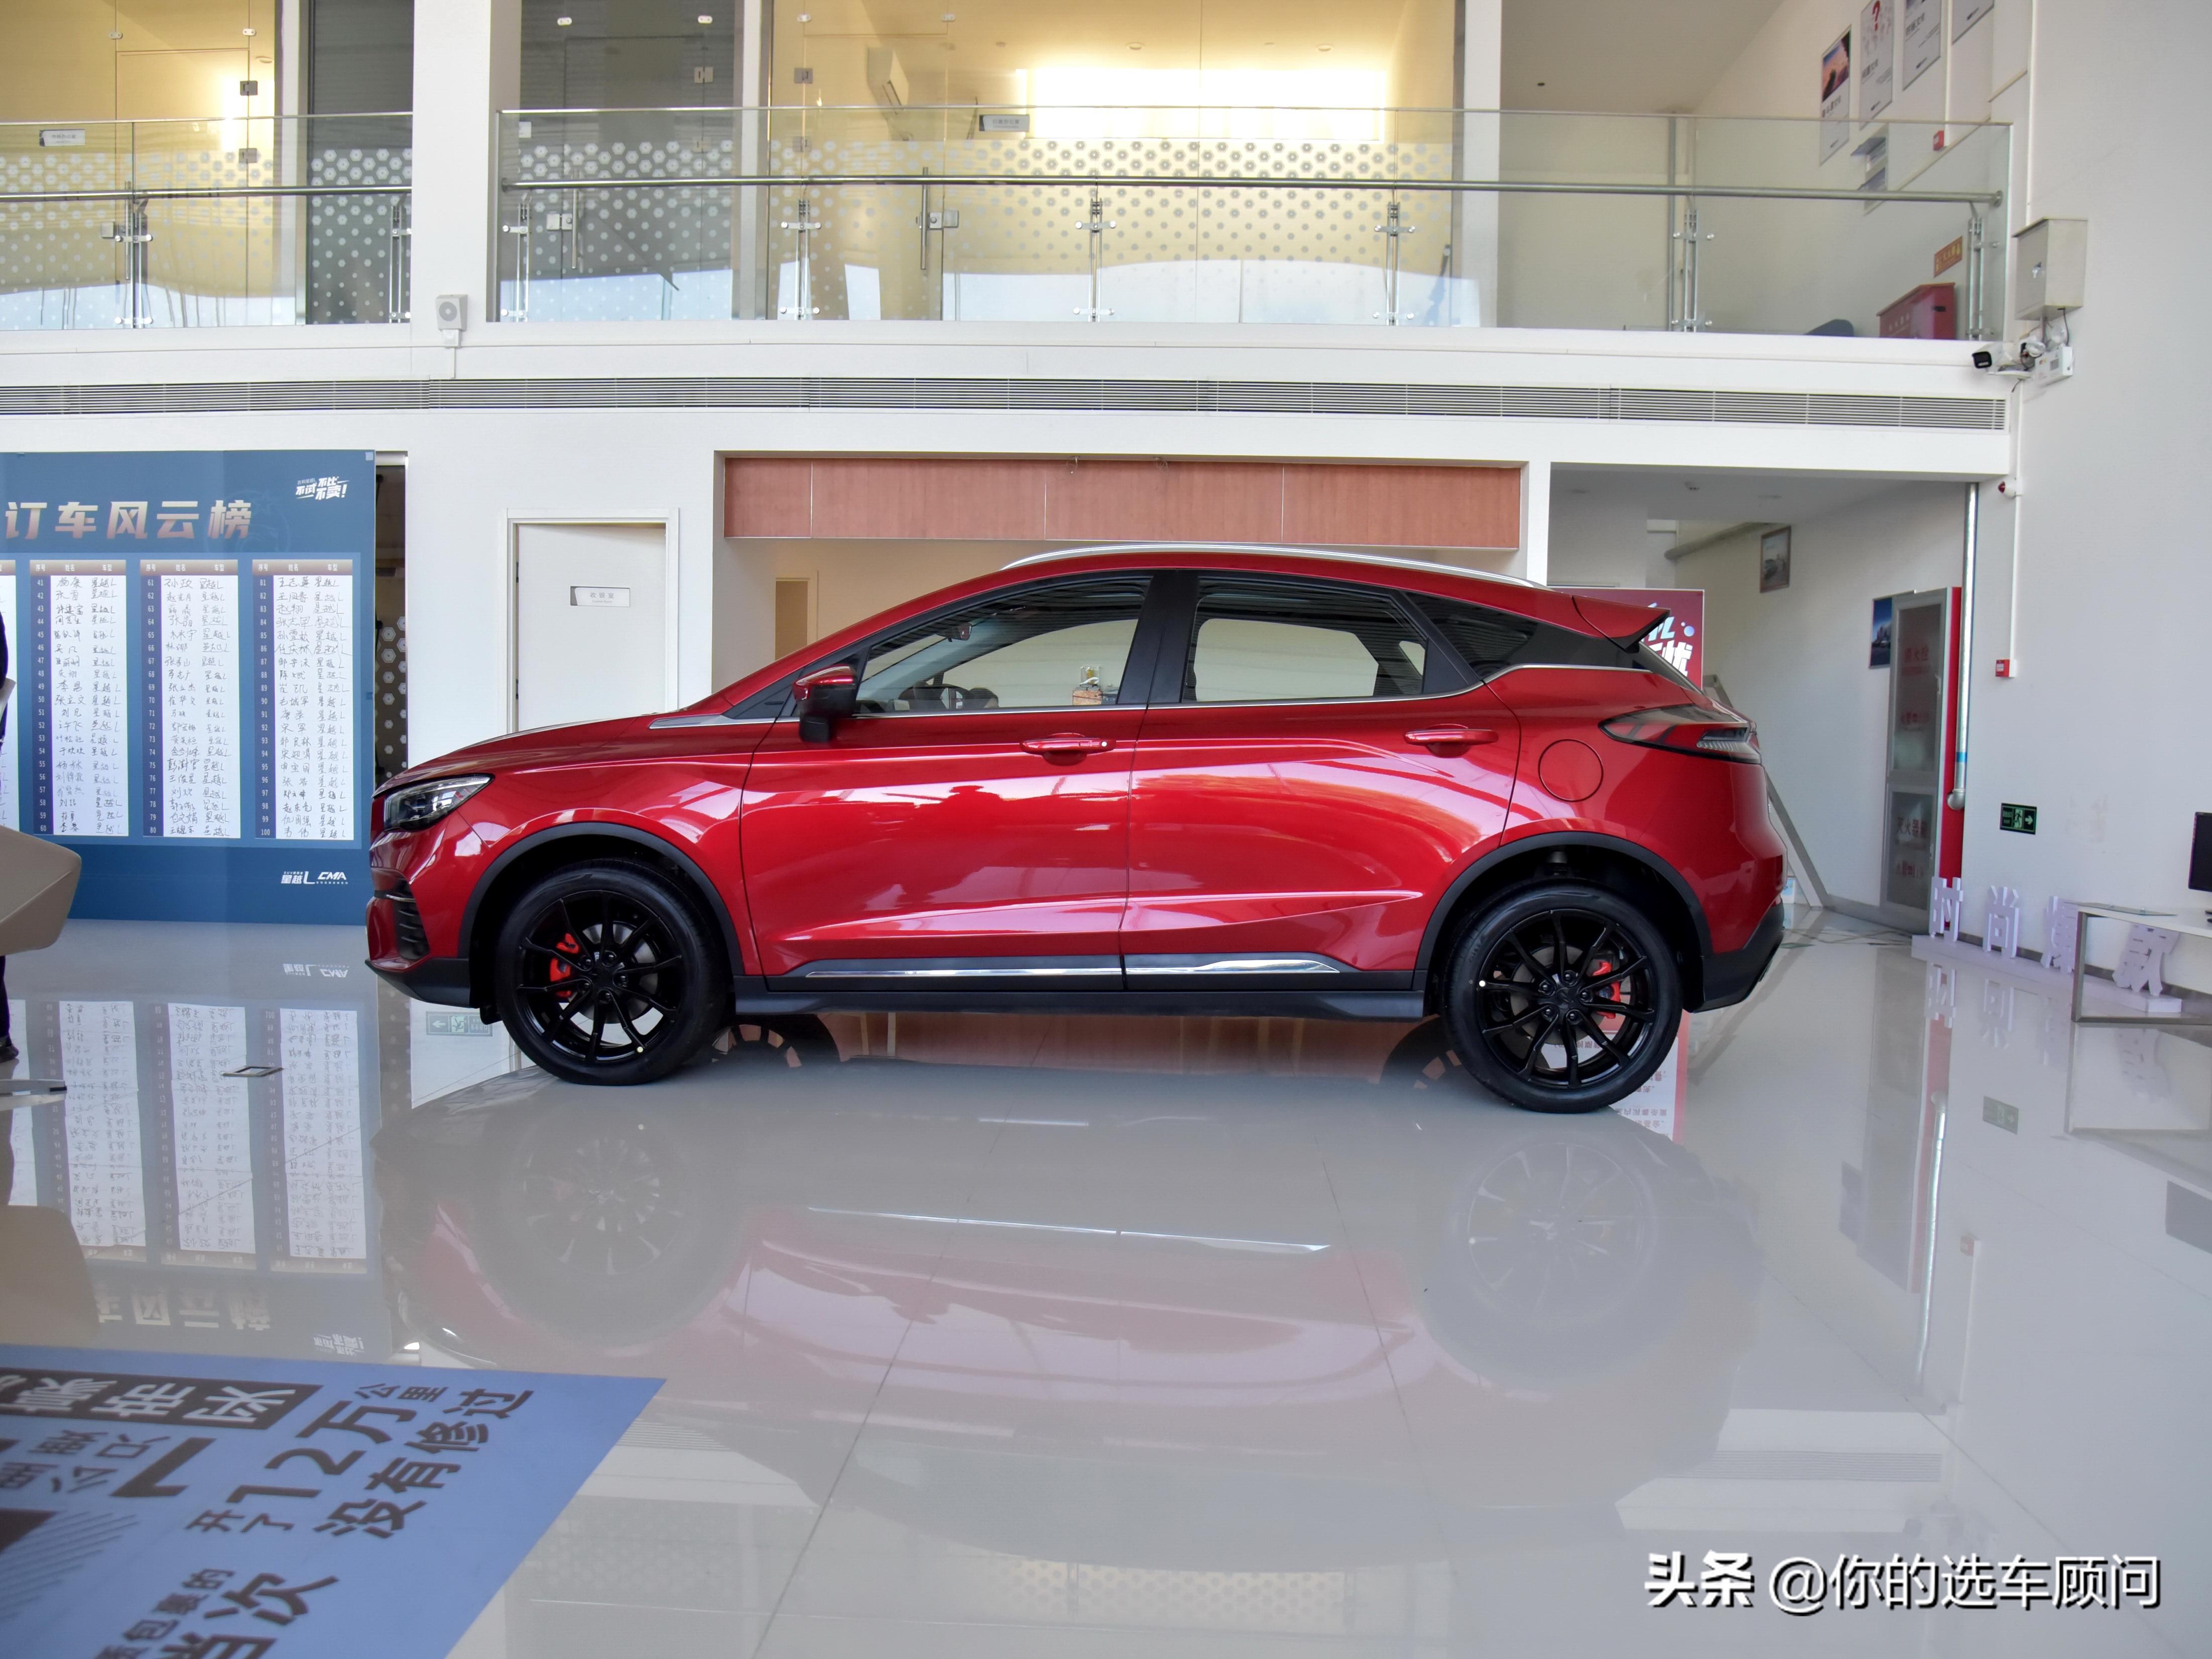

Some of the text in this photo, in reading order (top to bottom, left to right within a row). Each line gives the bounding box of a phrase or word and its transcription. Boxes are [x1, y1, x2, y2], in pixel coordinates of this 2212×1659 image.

[5, 500, 252, 539] 订车风云榜
[281, 871, 347, 884] 星越L CMA
[312, 1388, 534, 1539] 没有修过
